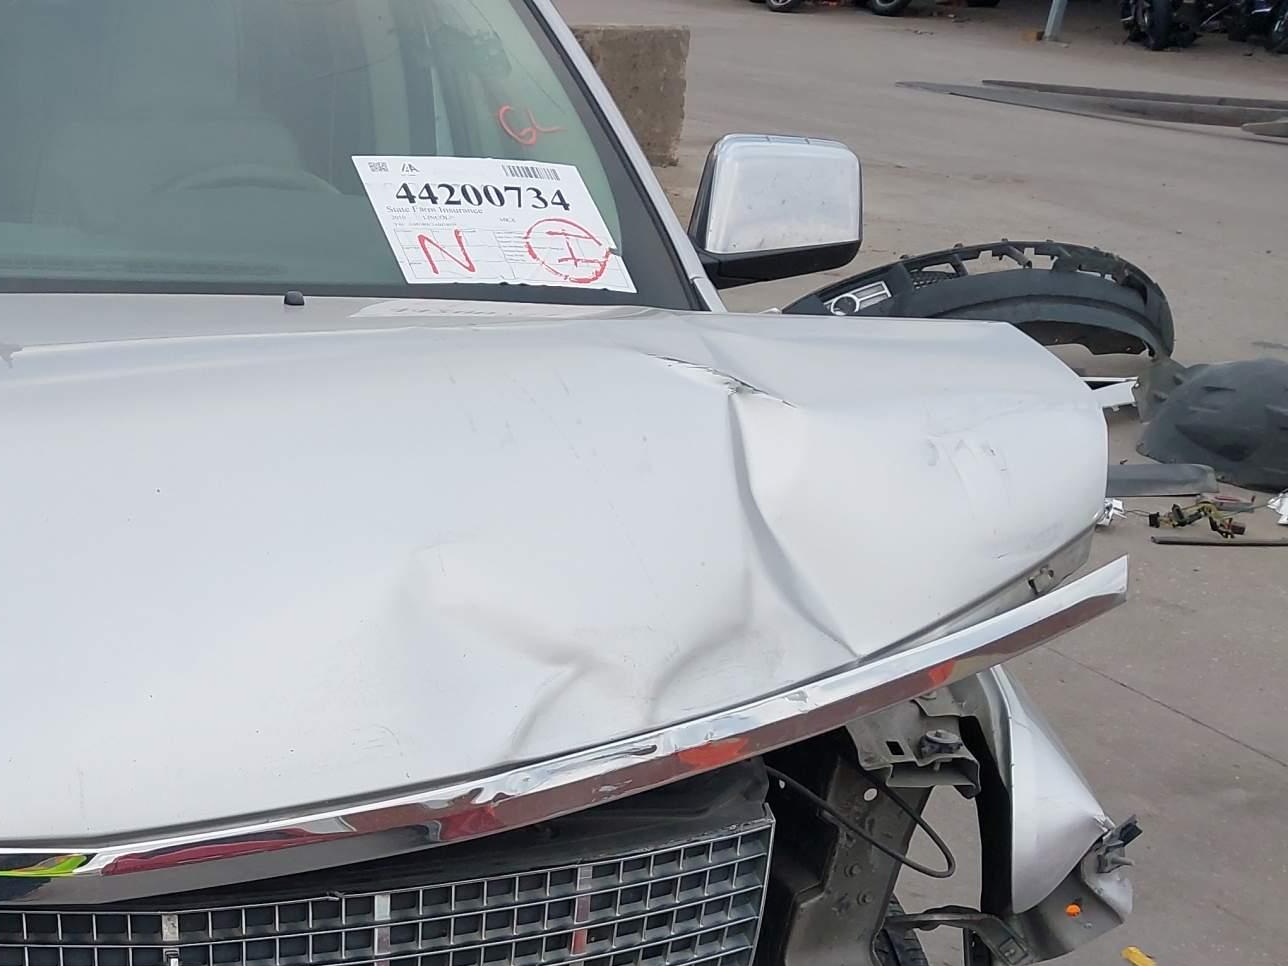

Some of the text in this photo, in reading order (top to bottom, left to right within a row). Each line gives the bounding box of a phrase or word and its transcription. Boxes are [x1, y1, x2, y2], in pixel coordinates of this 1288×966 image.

[386, 205, 483, 215] State Farm Insurance
[395, 182, 571, 211] 44200734
[417, 228, 476, 275] N
